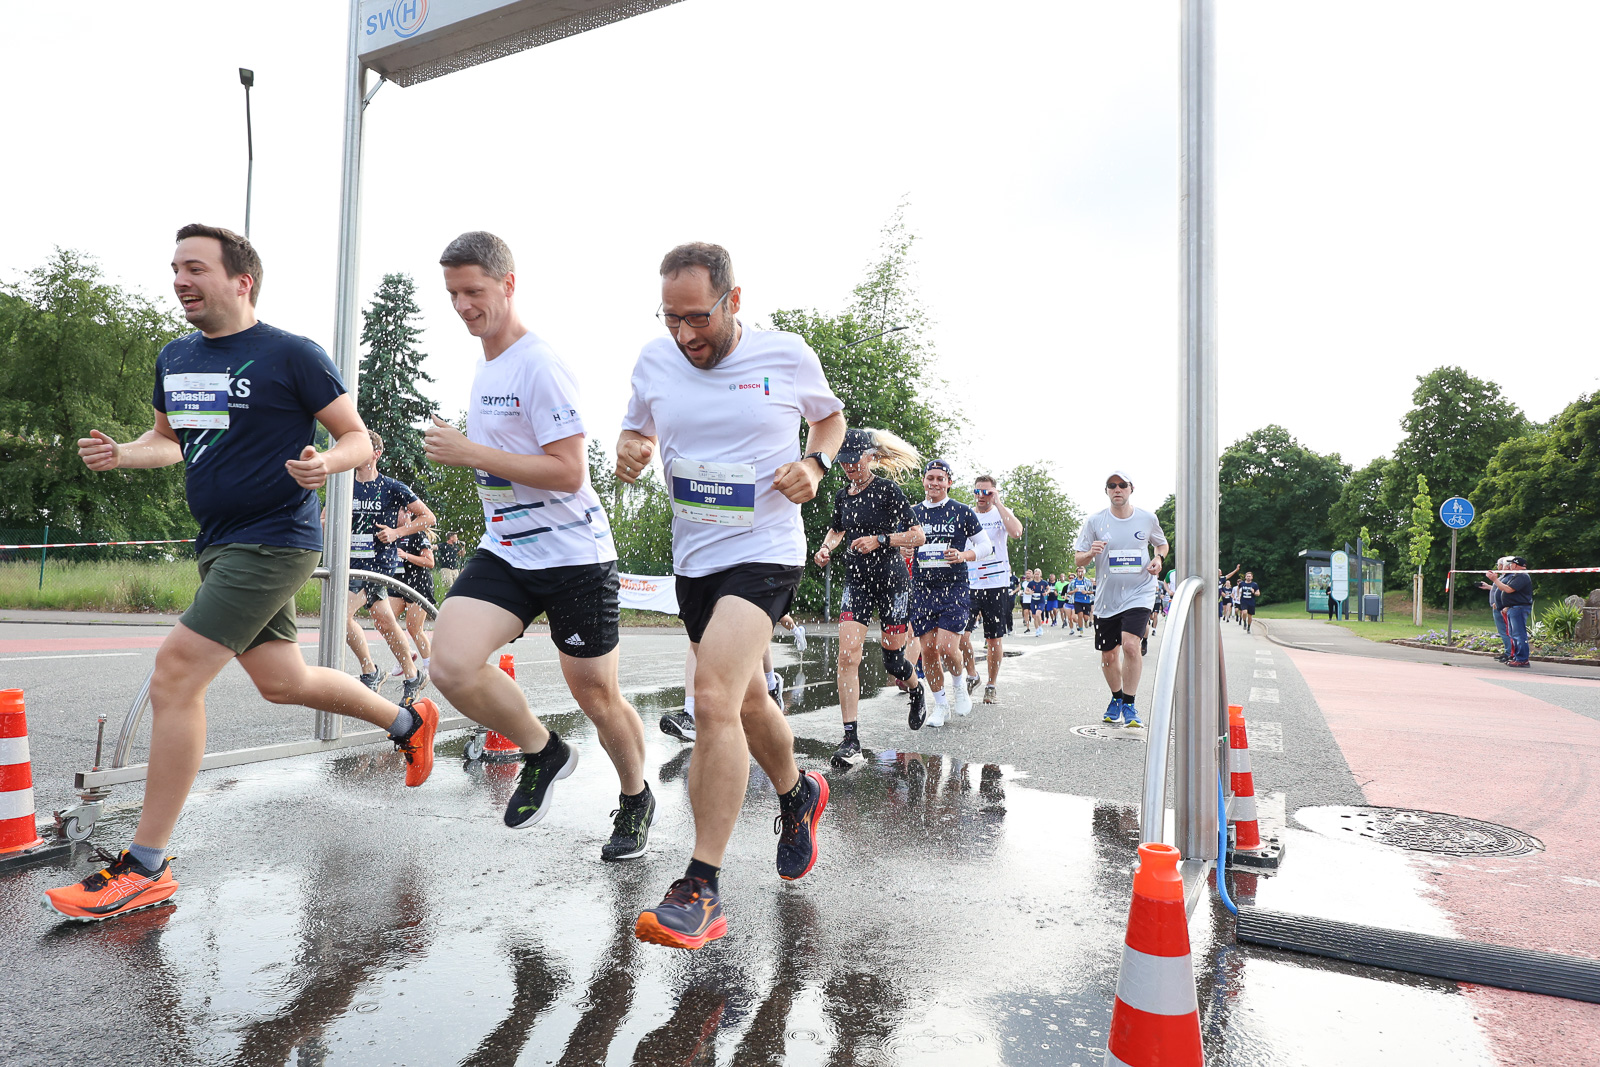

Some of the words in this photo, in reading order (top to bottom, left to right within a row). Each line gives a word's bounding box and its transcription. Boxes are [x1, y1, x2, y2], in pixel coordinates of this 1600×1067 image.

[171, 391, 216, 402] Sebastian
[481, 393, 520, 408] rexroth
[690, 480, 733, 496] Dominc
[362, 500, 382, 510] UKS
[704, 496, 717, 504] 297
[934, 523, 955, 533] UKS
[620, 577, 658, 592] MiniTec
